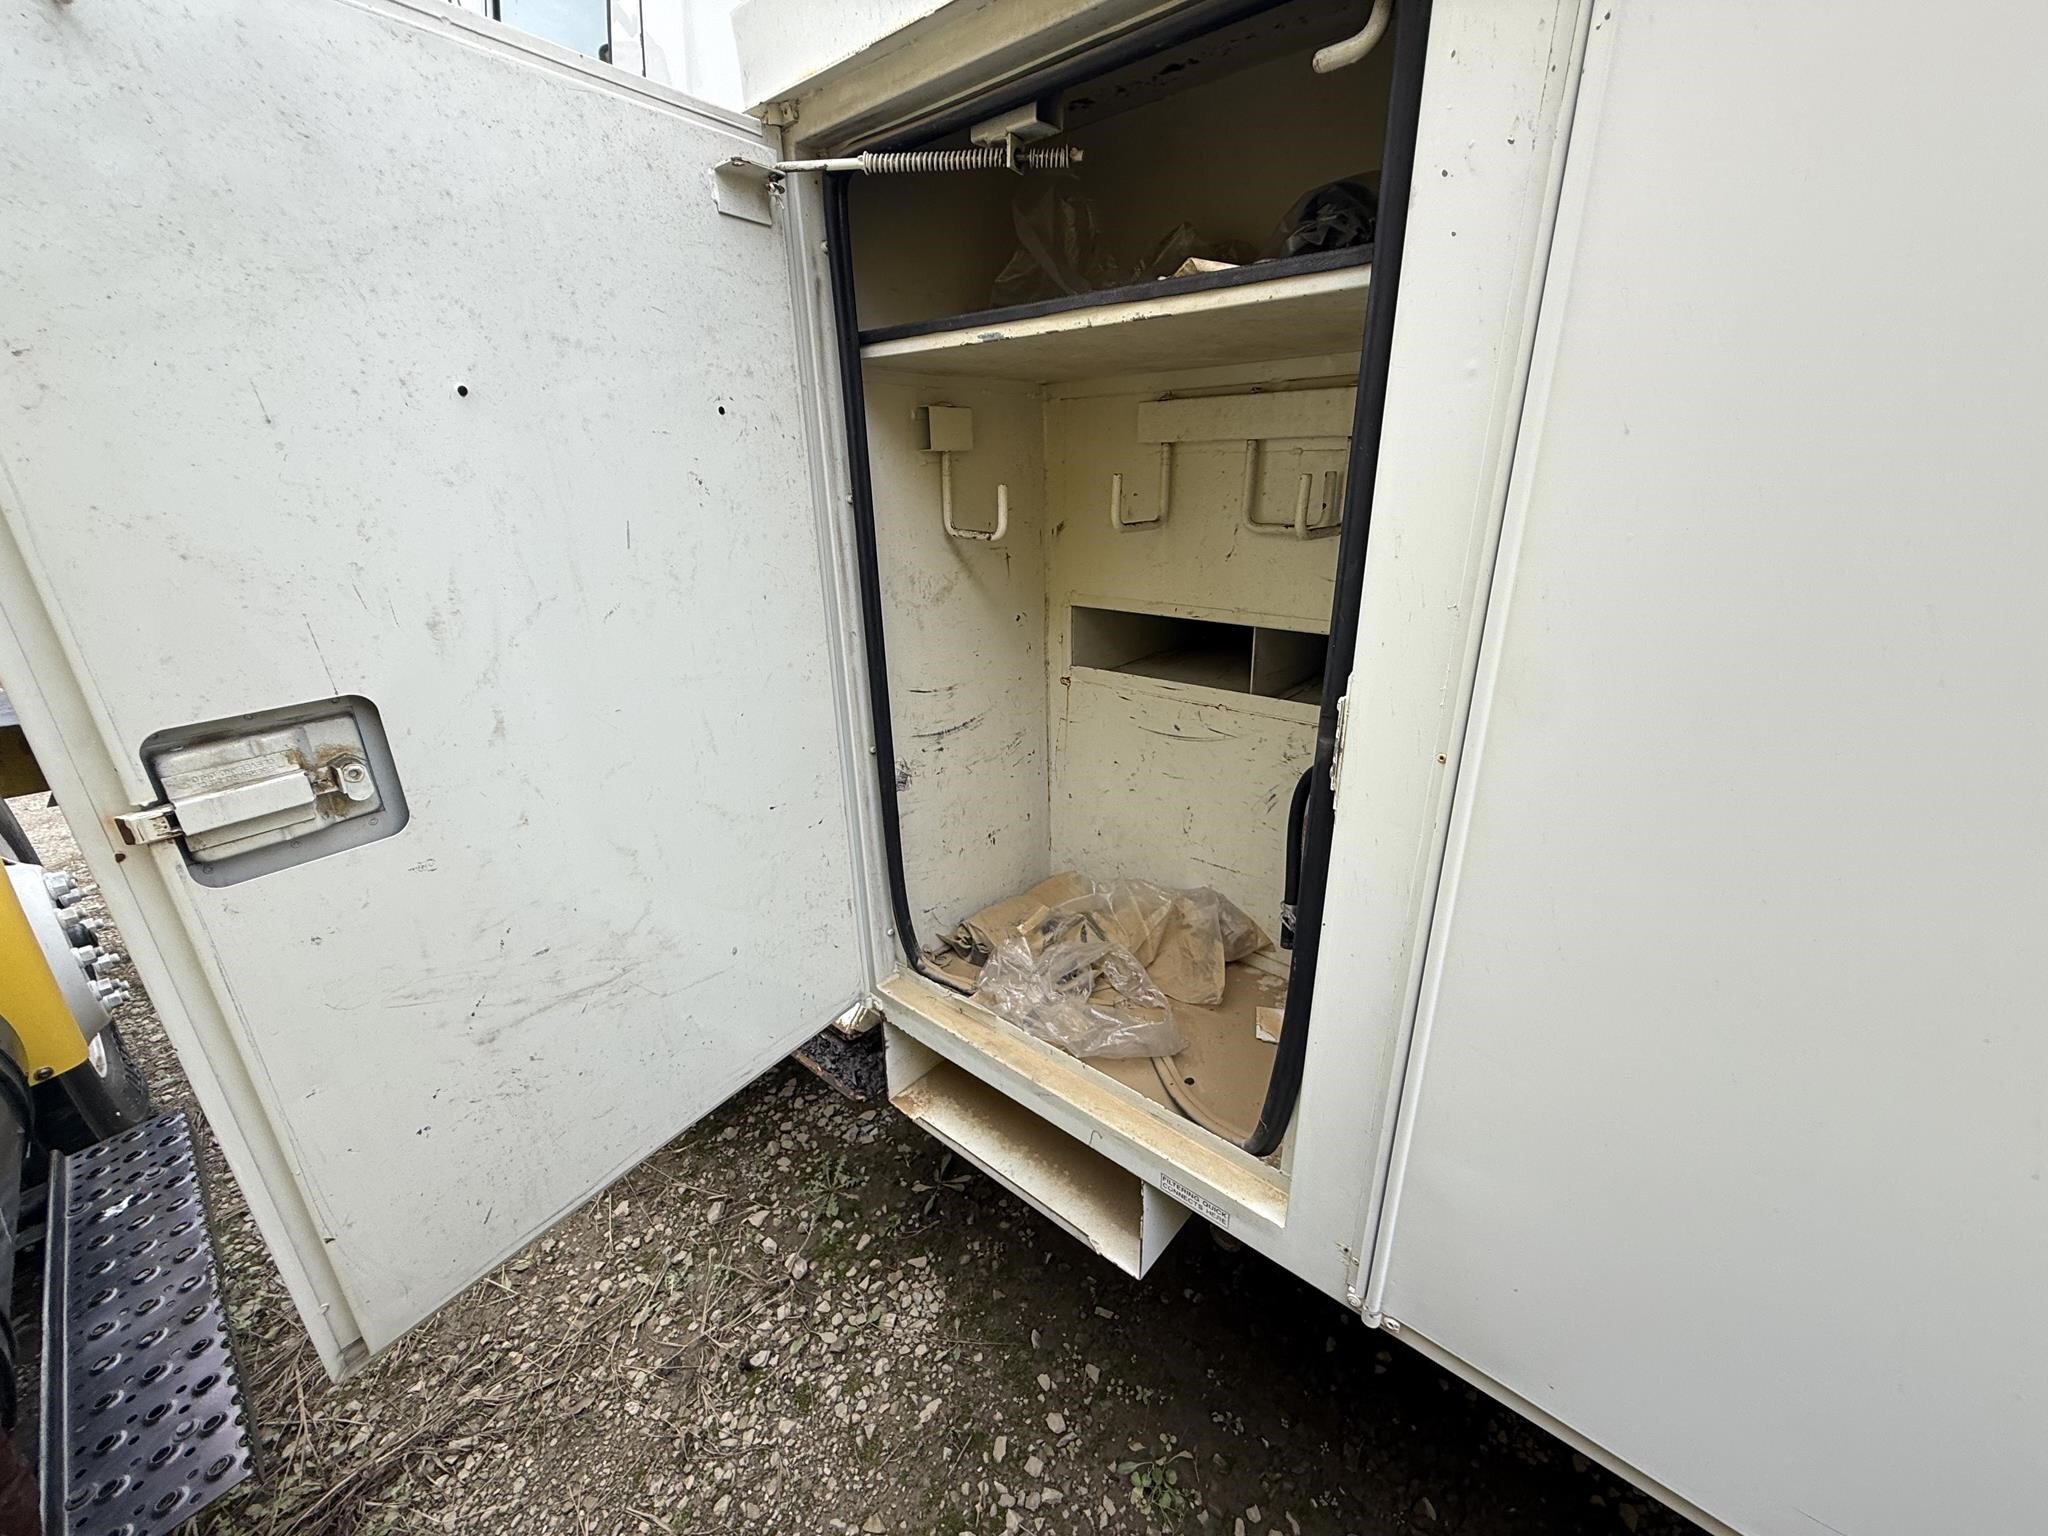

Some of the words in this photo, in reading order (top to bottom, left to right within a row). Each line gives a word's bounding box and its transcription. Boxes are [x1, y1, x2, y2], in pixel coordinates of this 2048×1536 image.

[1162, 1176, 1200, 1202] FILTERING
[1202, 1200, 1227, 1218] QUICK
[1162, 1182, 1203, 1211] CONNECTS
[1206, 1208, 1227, 1226] HERE
